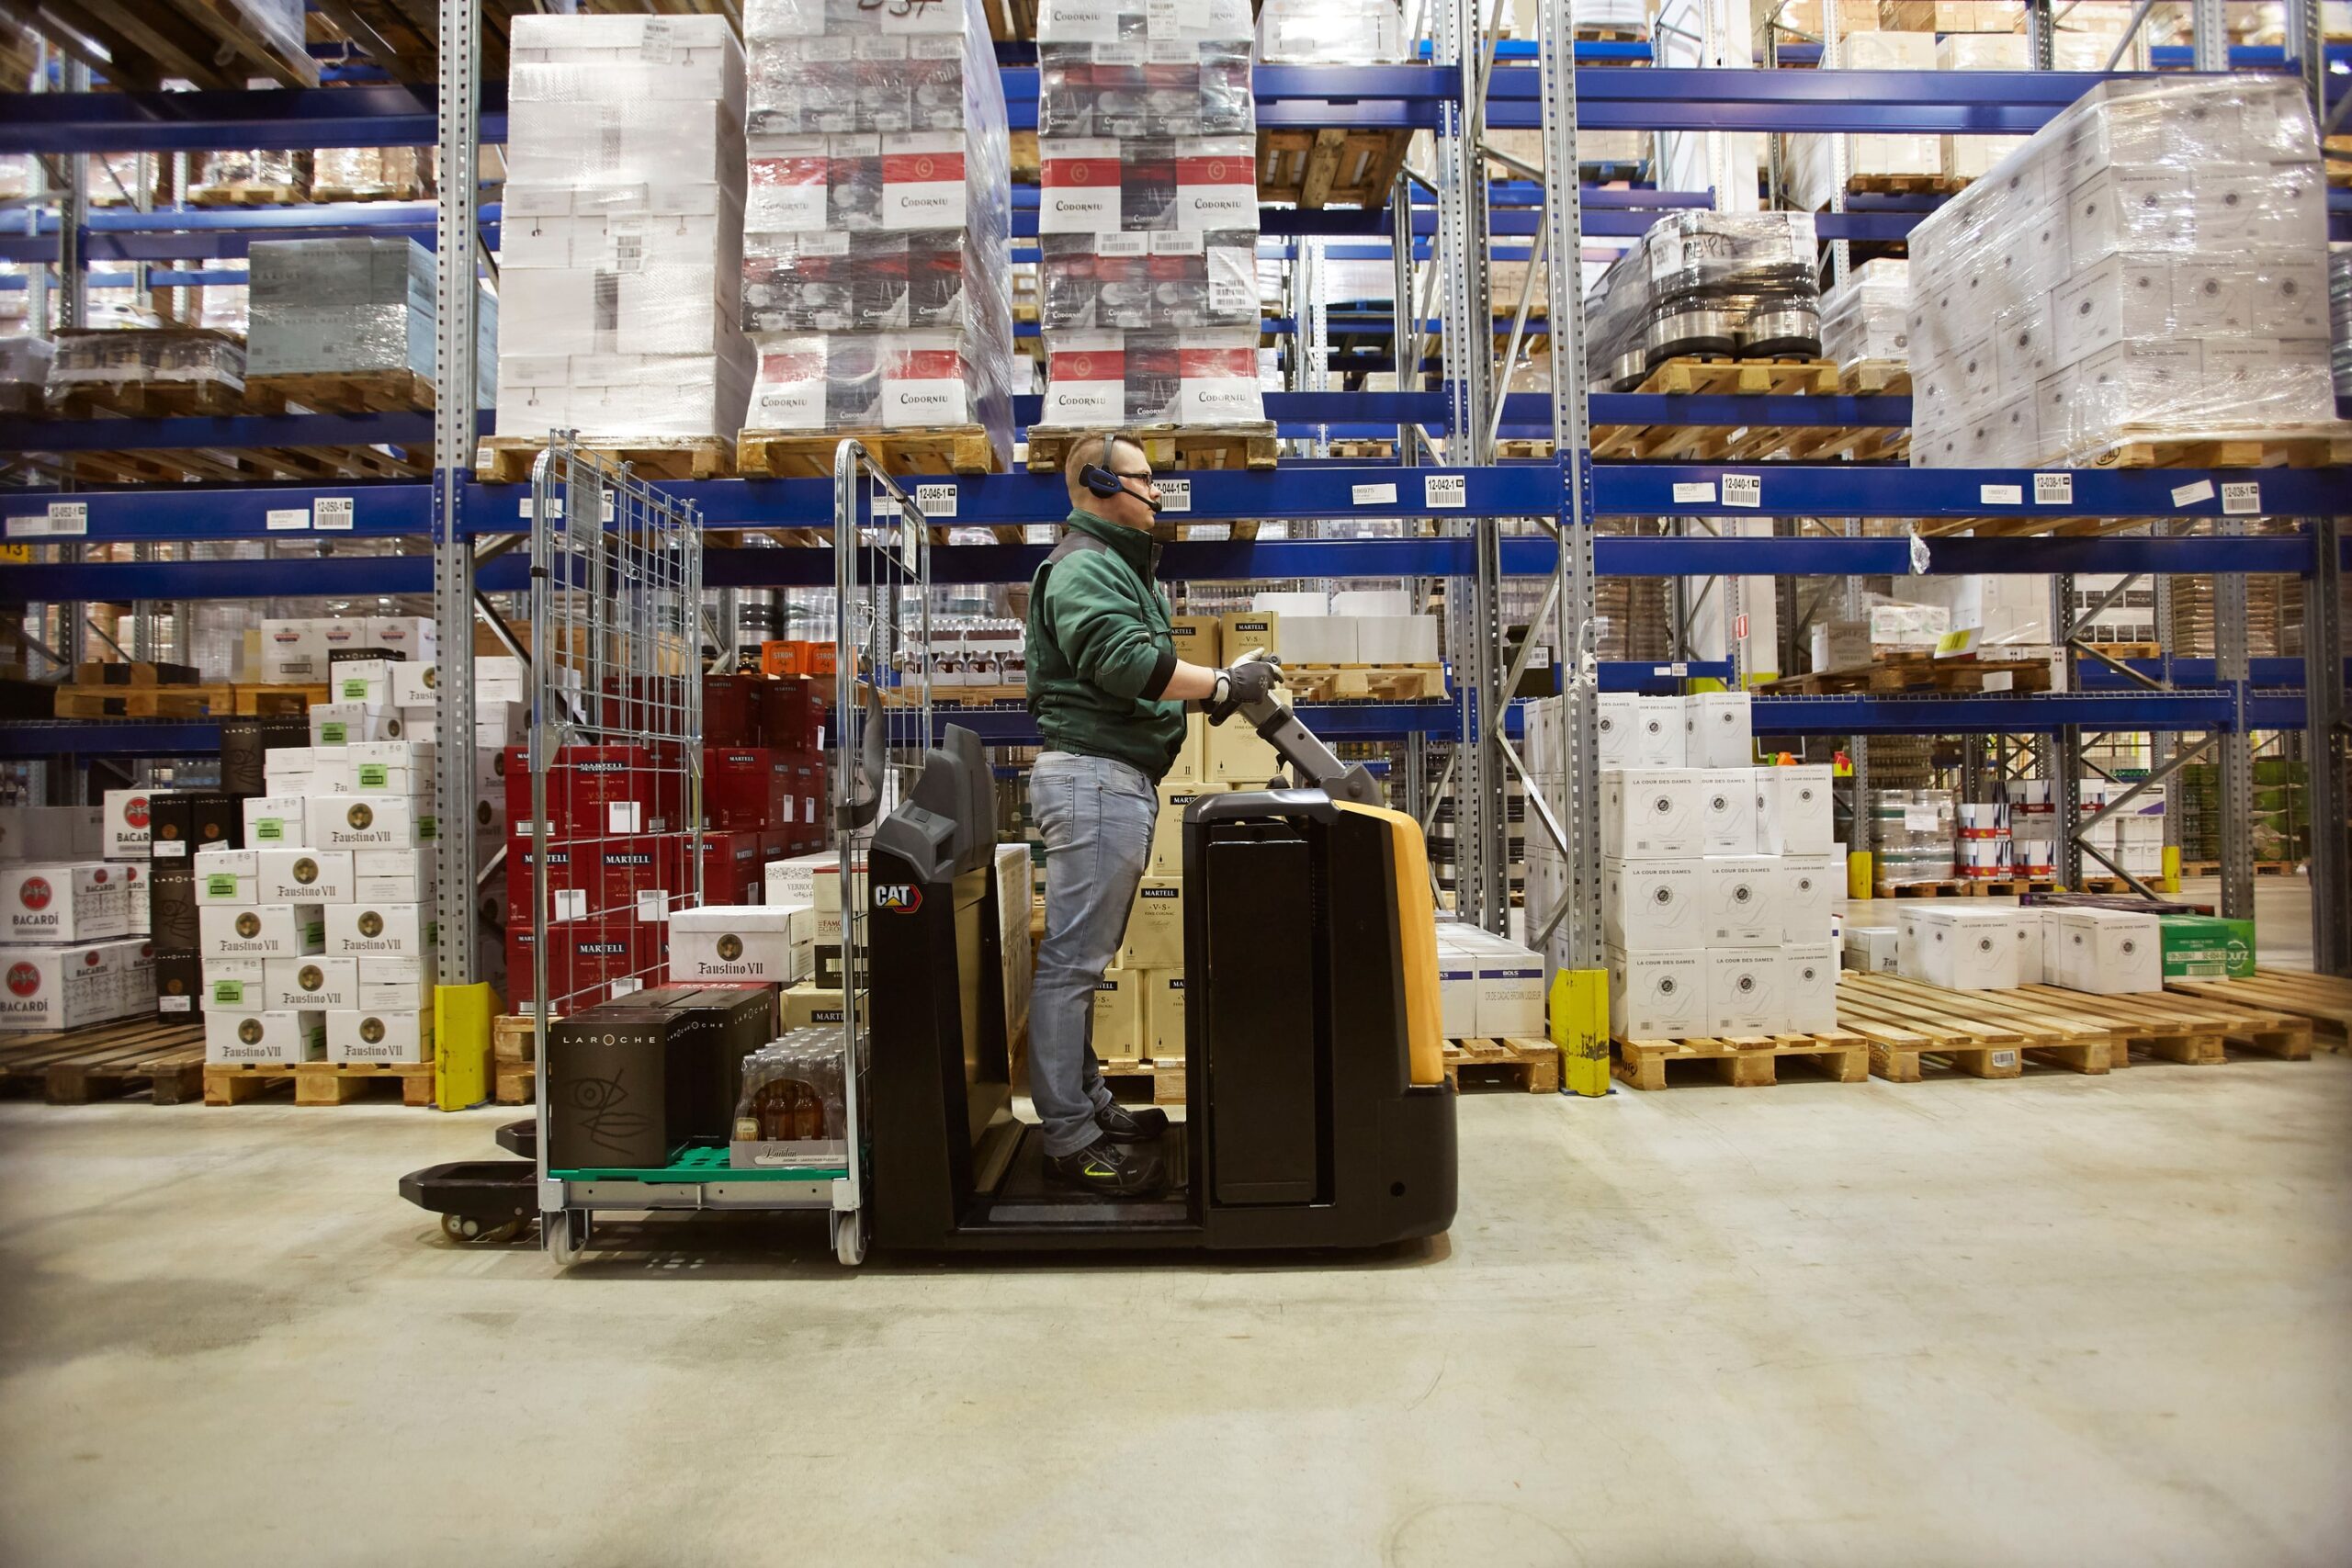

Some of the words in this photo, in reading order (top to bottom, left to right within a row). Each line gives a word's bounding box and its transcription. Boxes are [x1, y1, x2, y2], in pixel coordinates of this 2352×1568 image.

[1428, 479, 1455, 491] 12-042-1
[1725, 478, 1750, 490] 12-040-1
[920, 488, 946, 500] 12-046-1
[772, 651, 795, 660] STROH
[117, 832, 150, 842] BACAR
[332, 831, 375, 842] Faustino
[525, 854, 569, 863] MTELL
[605, 855, 650, 863] MARTELL
[277, 886, 321, 897] Faustino
[876, 886, 910, 908] CAT
[13, 912, 59, 925] BACARDÍ
[220, 940, 263, 952] Faustino
[343, 939, 385, 951] Faustino
[580, 944, 625, 953] MARTELL
[698, 962, 745, 976] Faustino
[747, 963, 763, 975] VII
[283, 993, 325, 1004] Faustino
[1, 998, 48, 1011] BACARDÍ
[563, 1033, 656, 1046] LAROCHE
[222, 1046, 266, 1057] Faustino
[345, 1045, 388, 1056] Faustino
